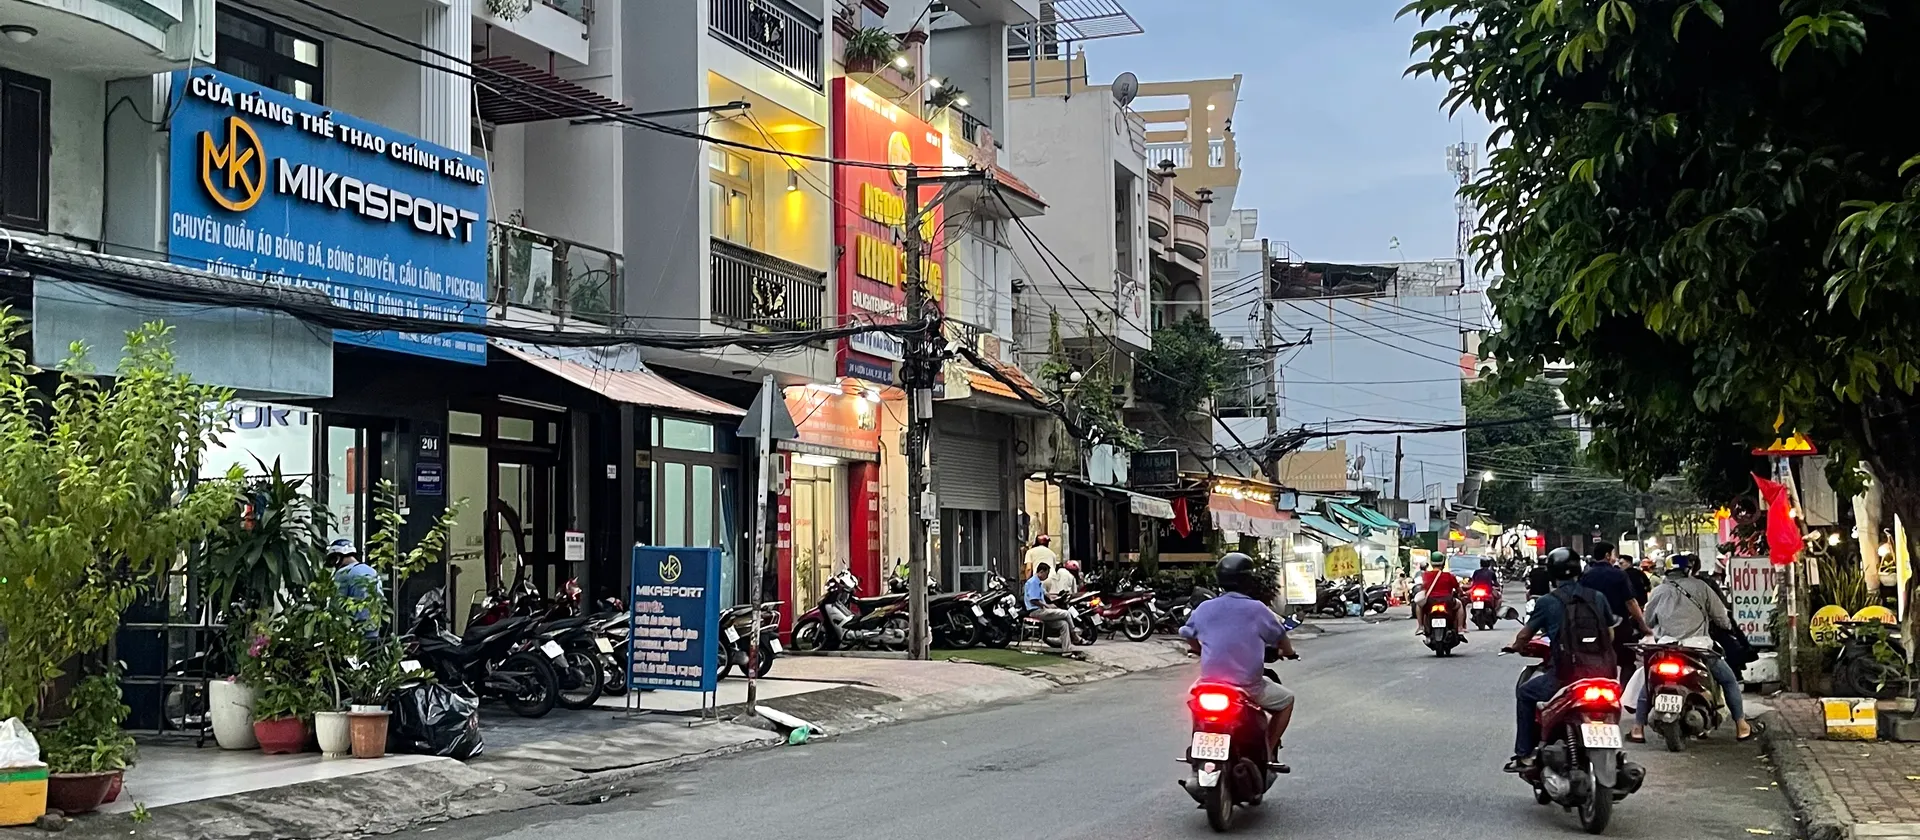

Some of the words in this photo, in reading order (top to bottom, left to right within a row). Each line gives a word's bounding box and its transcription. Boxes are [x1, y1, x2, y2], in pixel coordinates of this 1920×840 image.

[193, 73, 234, 107] CỬA
[300, 110, 334, 139] THỂ
[339, 124, 386, 154] THAO
[391, 142, 440, 171] CHÍNH
[444, 156, 485, 185] HÃNG
[279, 157, 480, 243] MIKASPORT
[172, 212, 221, 245] CHUYÊN
[223, 218, 255, 252] QUẦN
[257, 227, 272, 256] ÁO
[275, 232, 304, 263] BÓNG
[327, 245, 354, 274] BÓNG
[419, 266, 445, 296] LÔNG,
[857, 234, 897, 287] KHAI
[421, 437, 438, 450] 201
[635, 585, 705, 598] MIKASPORT
[1734, 595, 1760, 608] CẠO
